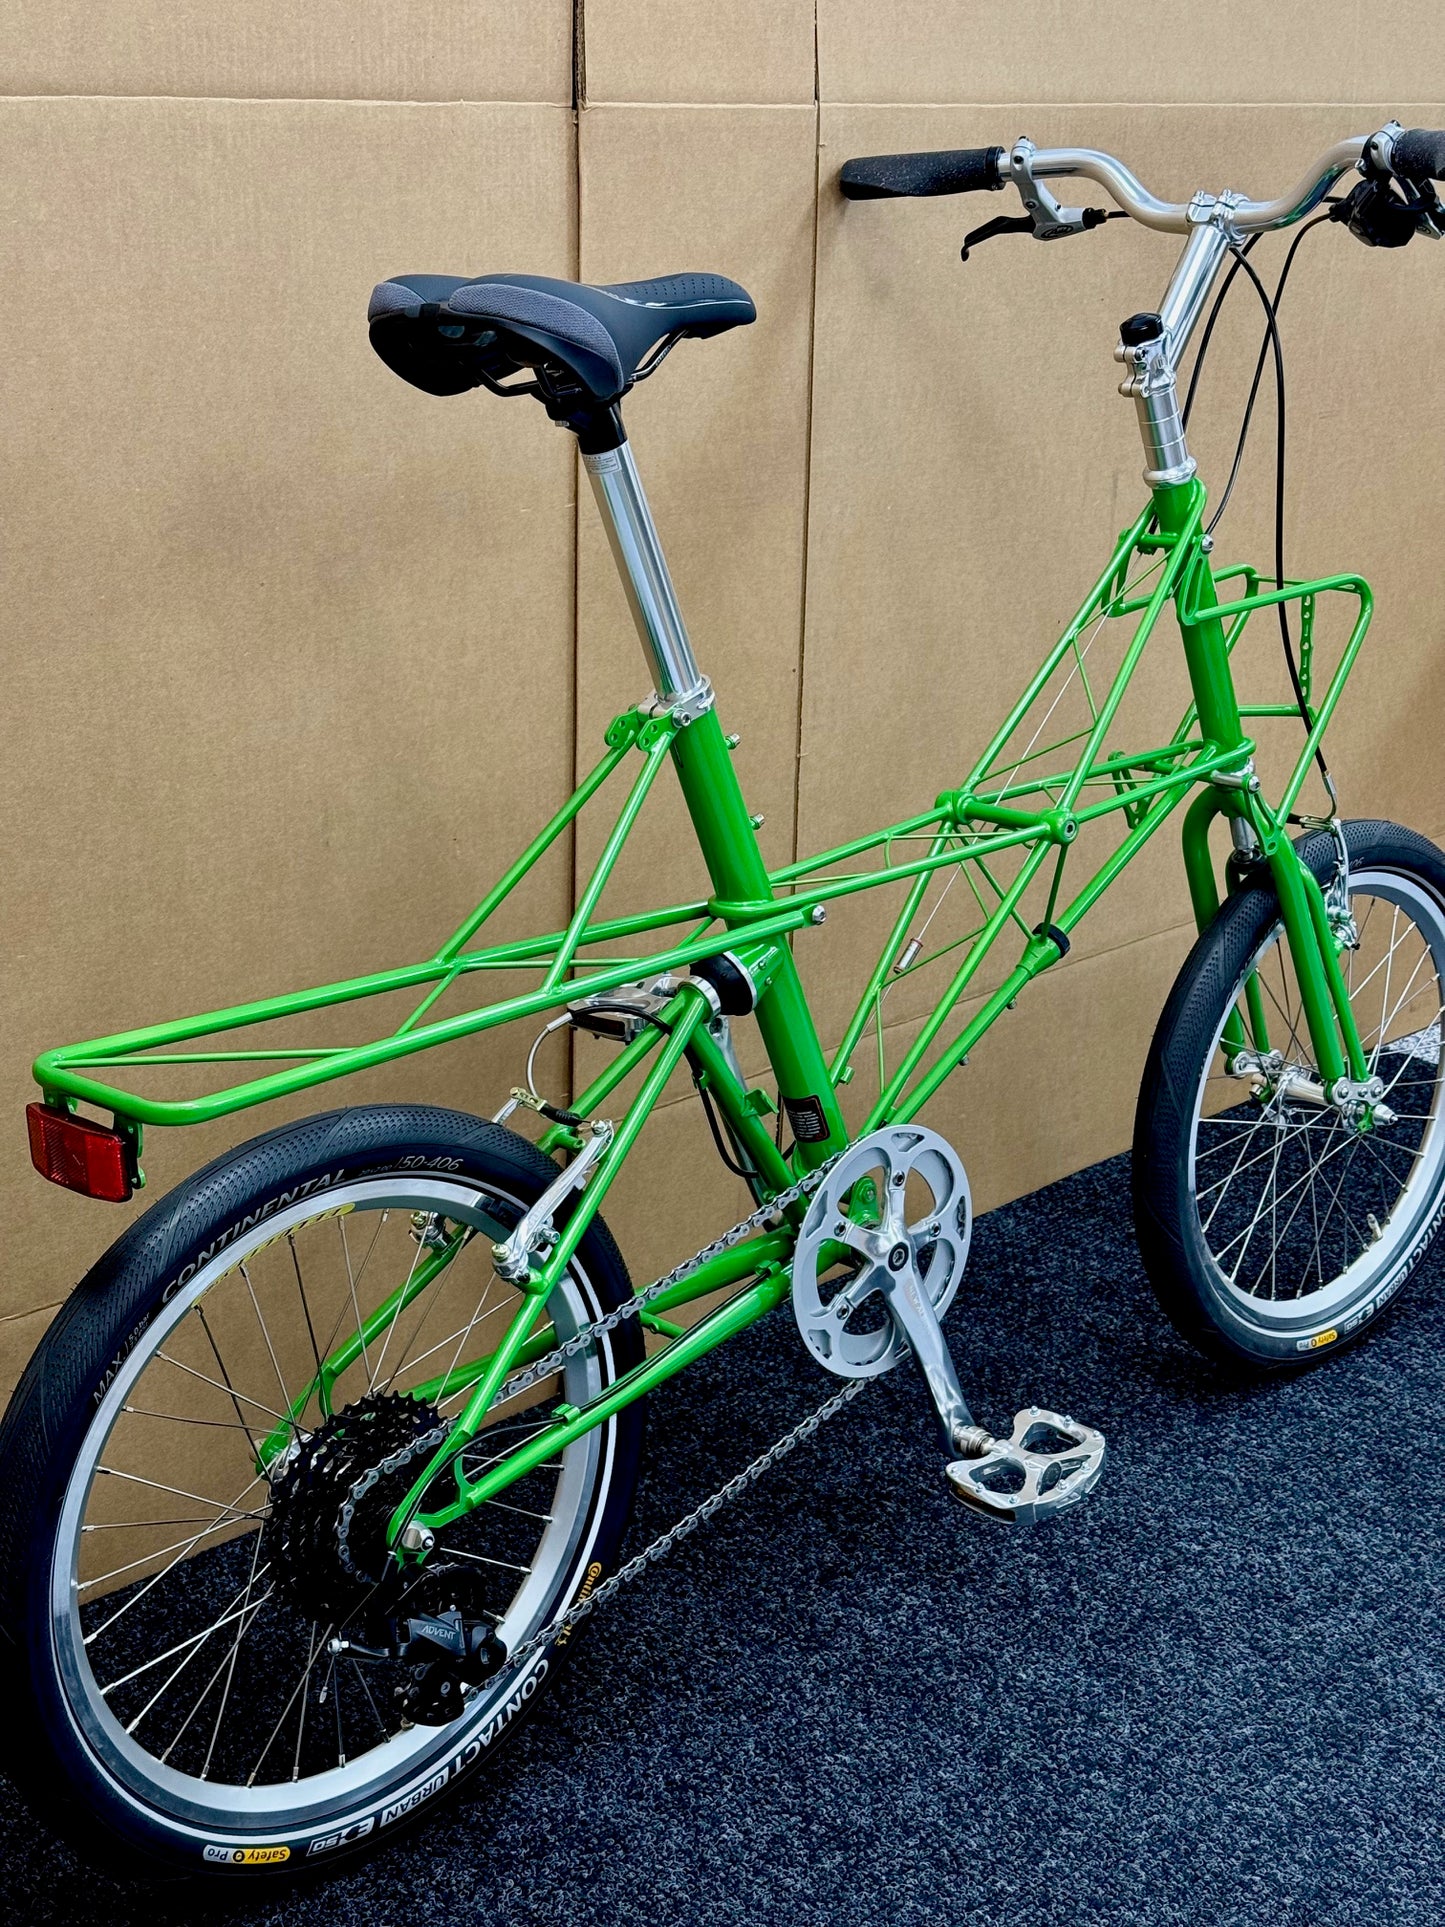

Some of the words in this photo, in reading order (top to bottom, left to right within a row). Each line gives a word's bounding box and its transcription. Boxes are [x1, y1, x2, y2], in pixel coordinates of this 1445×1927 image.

[162, 1168, 346, 1303] CONTINENTAL
[93, 1351, 126, 1405] MAX.
[421, 1625, 456, 1640] ADVENT
[450, 1659, 549, 1779] CONTACT
[383, 1773, 446, 1823] URBAN
[207, 1847, 229, 1861] Pro
[247, 1848, 287, 1861] Safety
